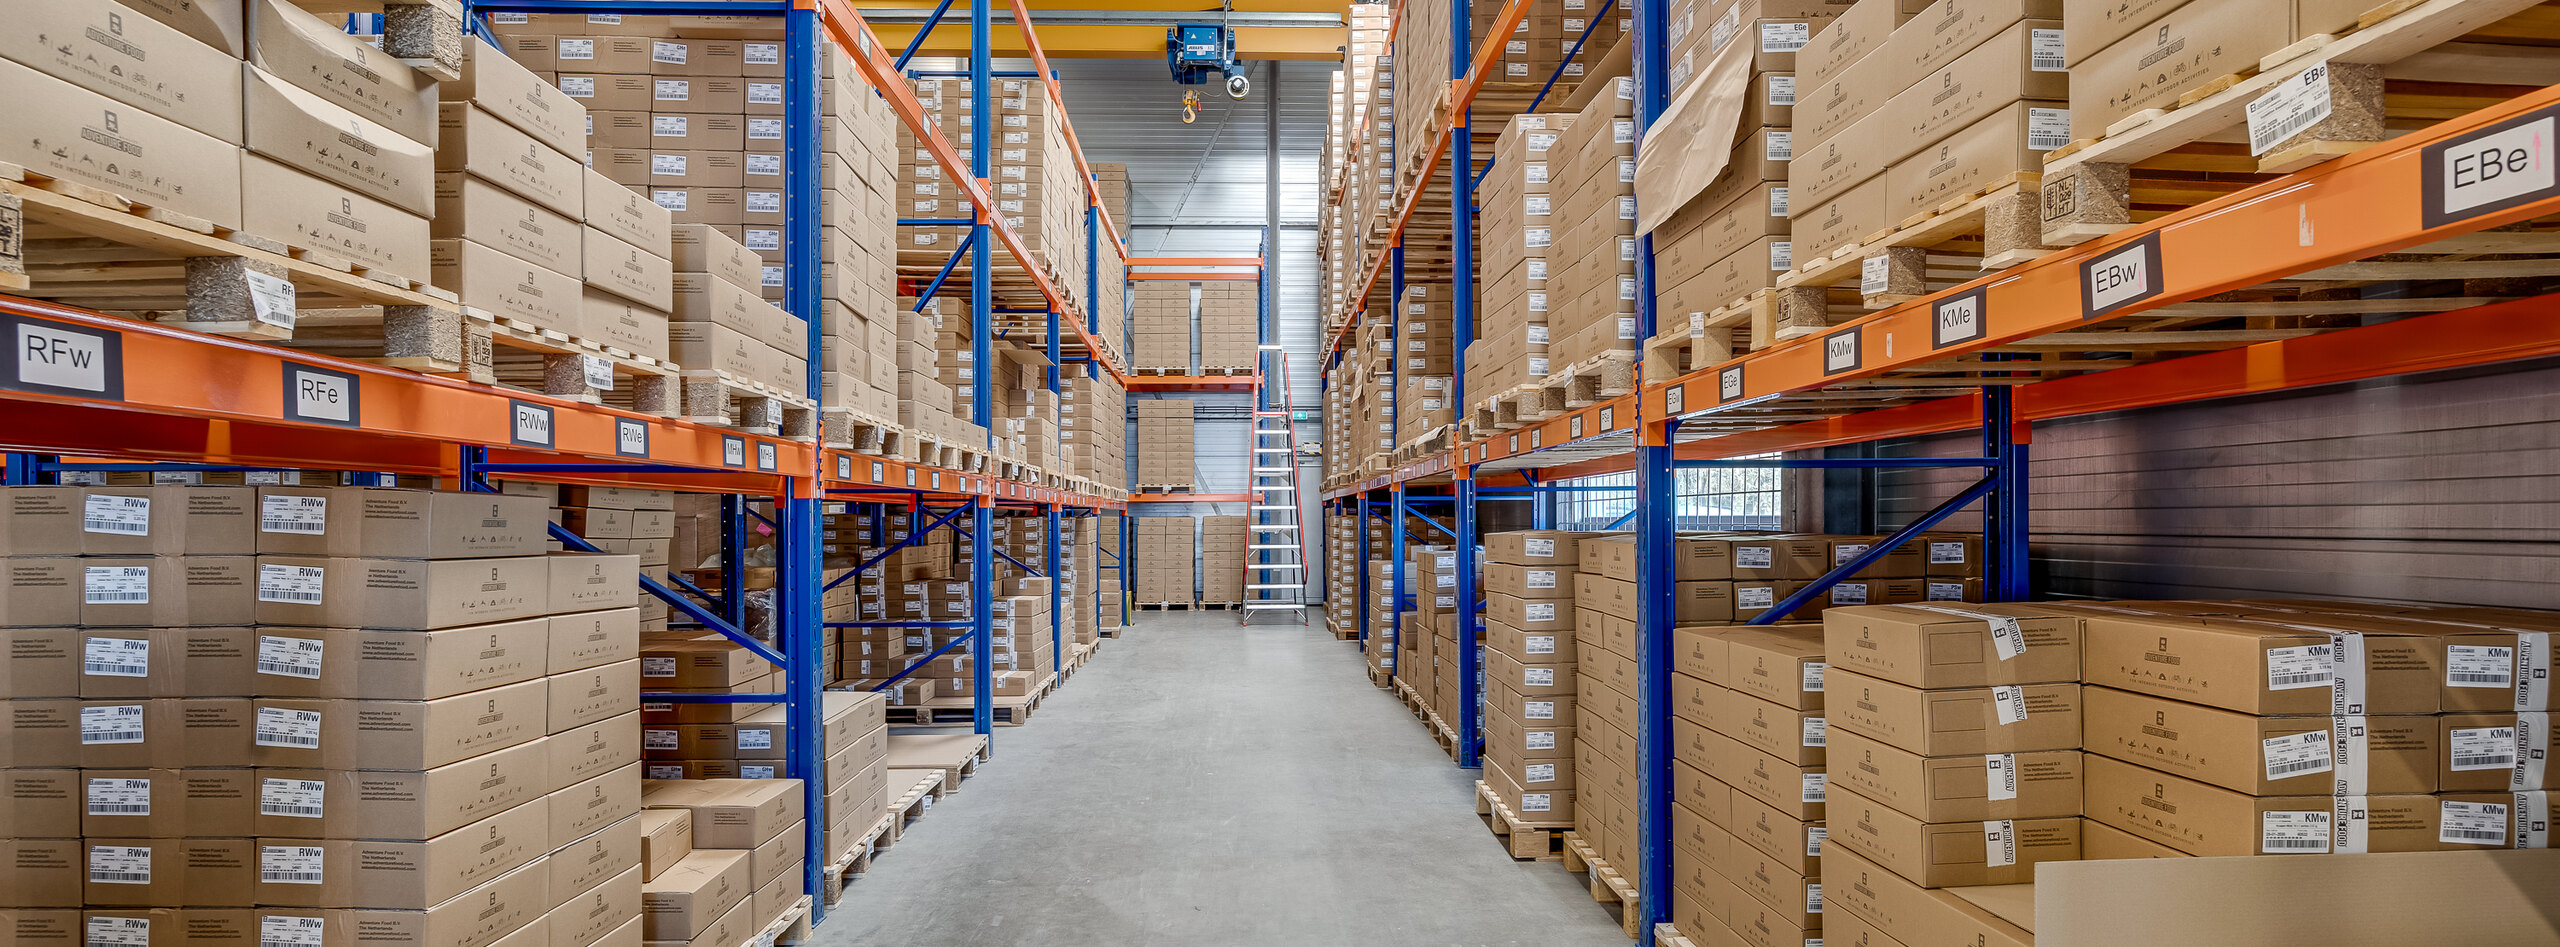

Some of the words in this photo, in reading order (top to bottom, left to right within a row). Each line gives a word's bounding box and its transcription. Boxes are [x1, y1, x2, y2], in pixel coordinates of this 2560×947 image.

[2303, 66, 2326, 86] EBe
[81, 127, 124, 152] ADVENTURE
[122, 141, 143, 158] FOOD
[2453, 147, 2529, 189] EBe
[2058, 201, 2070, 213] HT
[2095, 261, 2137, 294] EBw
[1942, 306, 1971, 330] KMe
[27, 334, 92, 369] RFw
[1830, 340, 1853, 359] KMw
[1724, 374, 1738, 390] EGe
[302, 378, 338, 404] RFe
[519, 411, 548, 432] RWw
[622, 427, 643, 444] RWe
[124, 498, 147, 508] RWw
[301, 497, 324, 507] RWw
[124, 567, 147, 577] RWw
[299, 567, 322, 578] RWw
[2006, 619, 2025, 655] ADVENTURE
[124, 640, 147, 651] RWw
[298, 641, 322, 653] RWw
[2308, 646, 2331, 656] KMw
[2334, 640, 2345, 663] FOOD
[2488, 648, 2510, 657] KMw
[2519, 640, 2531, 685] ADVENTURE
[2334, 677, 2346, 715] ADVENTUR
[2517, 684, 2528, 706] FOOD
[118, 706, 141, 717] RWw
[296, 711, 320, 722] RWw
[2303, 733, 2326, 744] KMw
[2490, 729, 2512, 739] KMw
[2517, 720, 2529, 763] ADVENTURE
[2337, 743, 2348, 765] FOOD
[2003, 754, 2015, 792] ADVENTURE
[2513, 762, 2526, 785] FOOD
[126, 779, 149, 789] RWw
[300, 780, 323, 791] RWw
[2482, 804, 2505, 815] KMw
[2516, 793, 2528, 838] ADVENTURE
[2305, 813, 2328, 823] KMw
[2003, 825, 2014, 863] ADVENTURE
[2337, 825, 2348, 847] FOOD
[127, 848, 150, 858] RWw
[299, 847, 322, 857] RWw
[125, 919, 148, 929] RWw
[299, 918, 323, 929] RWw
